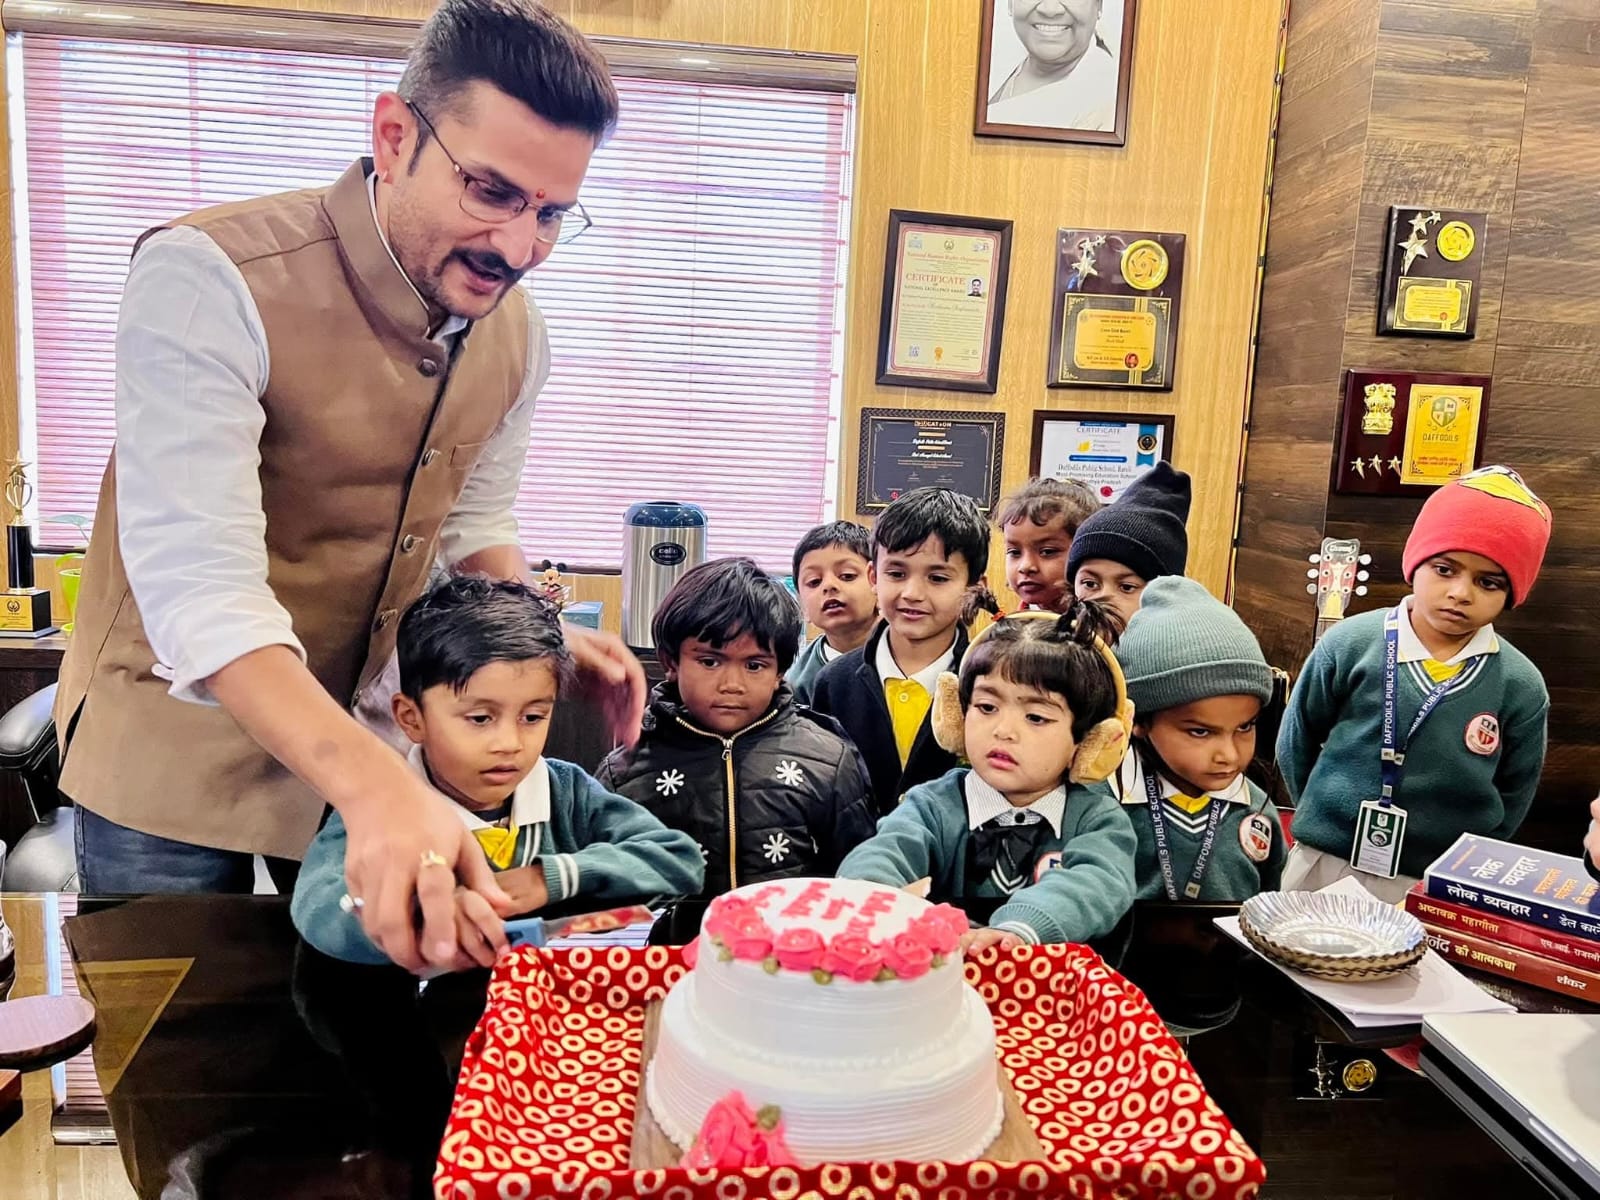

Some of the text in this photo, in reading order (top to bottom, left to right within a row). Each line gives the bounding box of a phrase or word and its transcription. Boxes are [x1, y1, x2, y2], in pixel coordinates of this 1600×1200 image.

[905, 273, 966, 285] CERTIFICATE
[1422, 433, 1459, 442] DAFFODILS
[1384, 640, 1396, 744] DAFFODILS PUBLIC SCHOOL
[1422, 686, 1445, 711] PUBLIC
[1152, 812, 1167, 848] PUBLIC
[1192, 800, 1221, 879] DAFFODILS PUBLIC
[1470, 858, 1505, 879] लोक
[1498, 855, 1540, 886] व्यवहार
[1417, 901, 1458, 921] अष्टावक्र
[1461, 913, 1500, 934] महागीता
[1446, 883, 1479, 902] लोक
[1482, 893, 1532, 918] व्यवहार
[1558, 913, 1577, 930] डेल
[1455, 944, 1470, 957] की
[1470, 950, 1518, 971] आत्मकथा
[1556, 975, 1587, 990] शंकर
